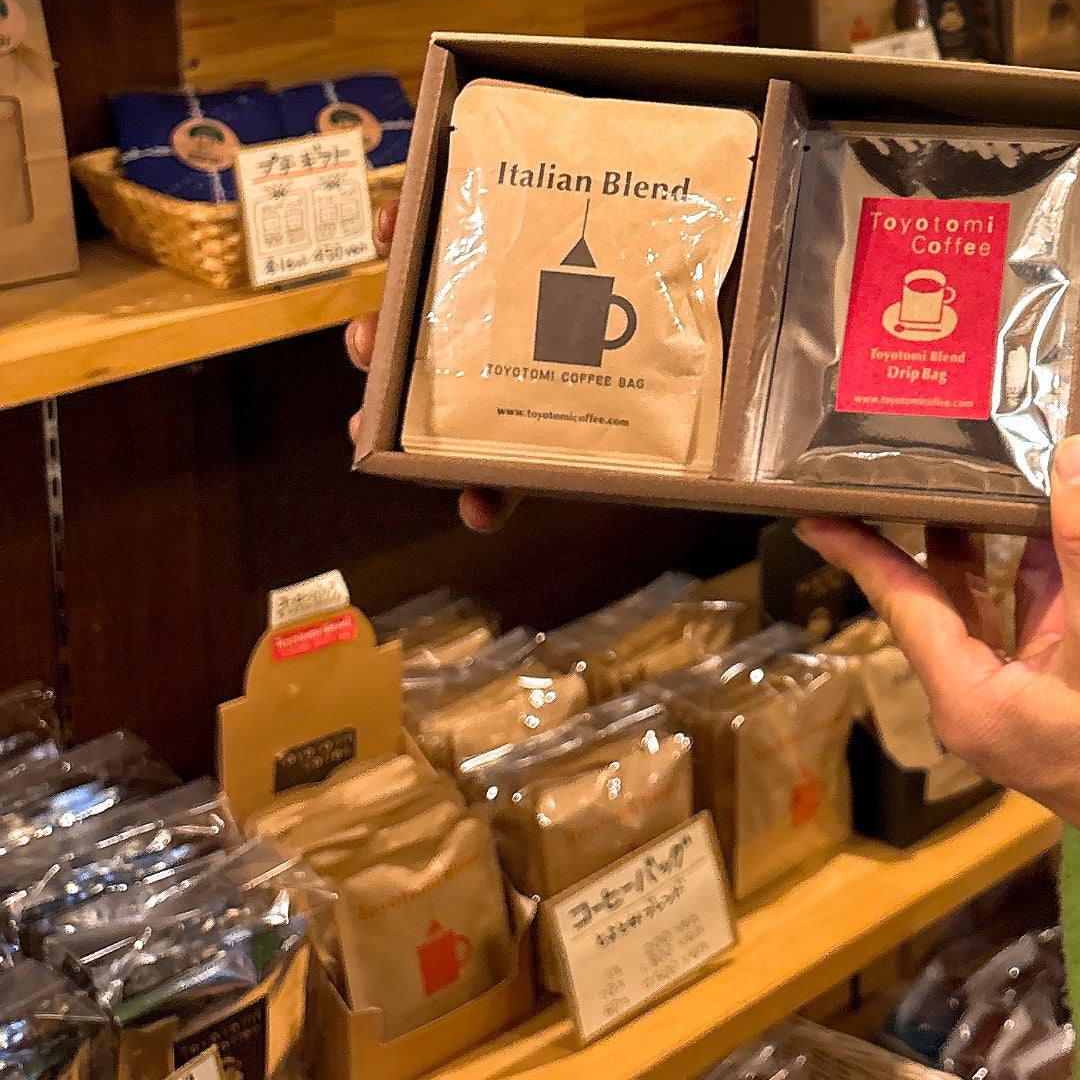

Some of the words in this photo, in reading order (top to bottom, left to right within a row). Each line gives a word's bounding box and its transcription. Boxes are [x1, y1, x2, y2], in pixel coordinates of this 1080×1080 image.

[497, 161, 592, 193] Italian
[601, 170, 691, 202] Blend
[870, 211, 994, 236] Toyotomi
[911, 235, 992, 257] Coffee
[870, 347, 927, 362] Toyotomi
[929, 350, 967, 364] Blend
[487, 363, 555, 382] TOYOTOMI
[561, 371, 612, 388] COFFEE
[617, 376, 645, 390] BAG
[887, 365, 920, 383] Drip
[921, 367, 948, 385] Bag
